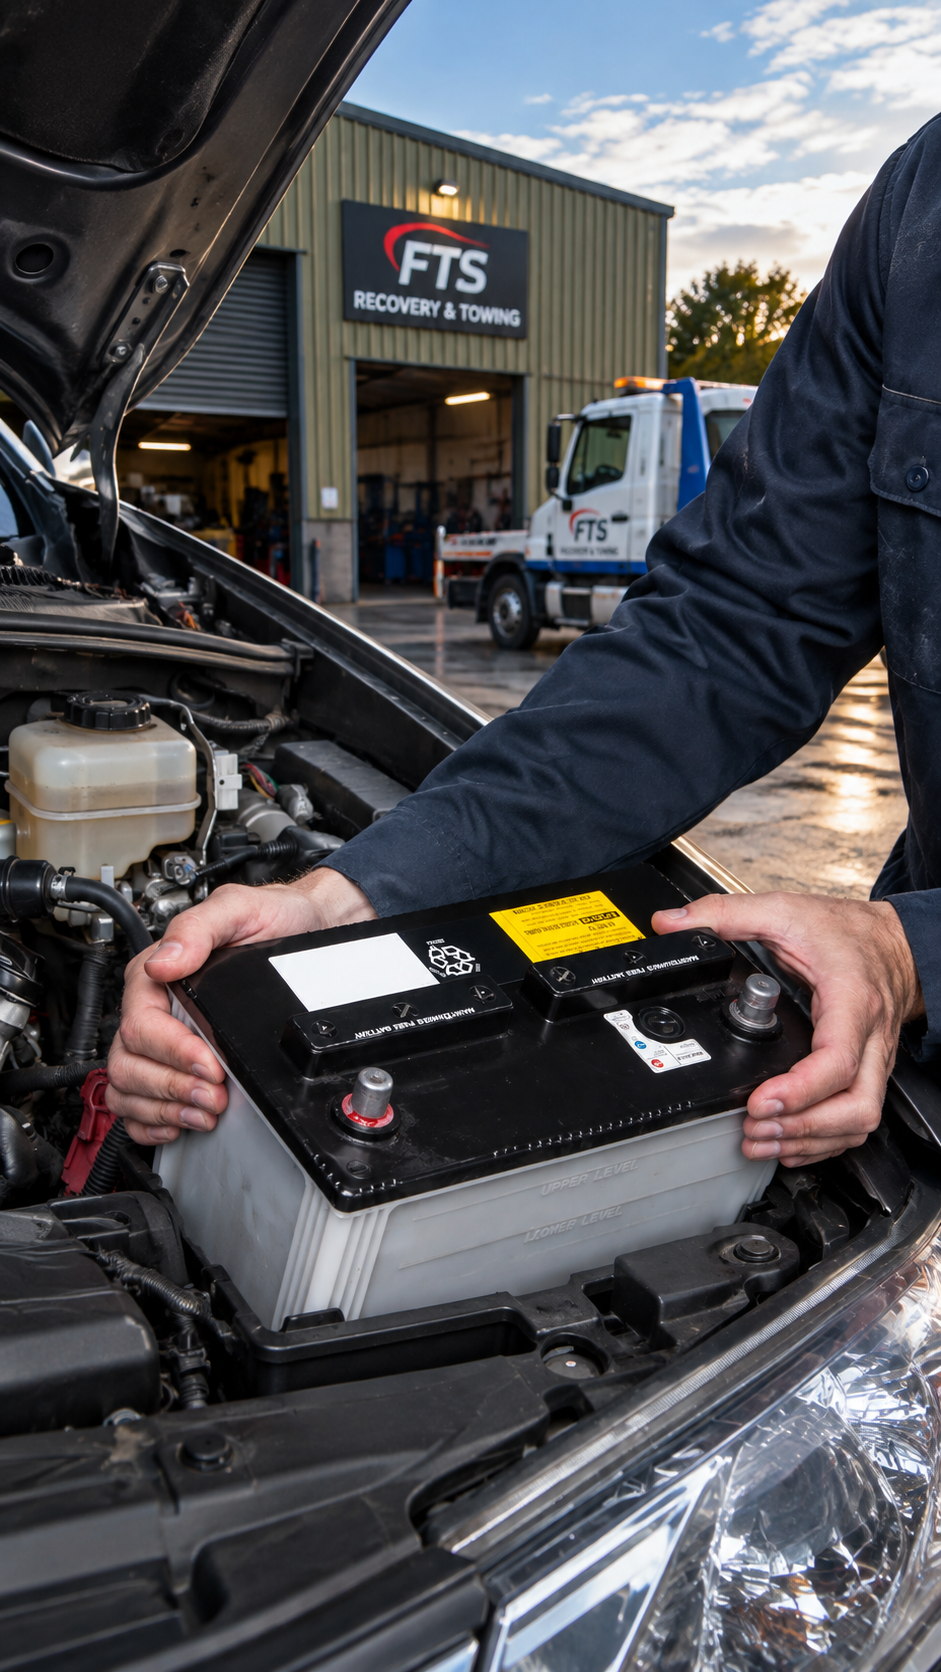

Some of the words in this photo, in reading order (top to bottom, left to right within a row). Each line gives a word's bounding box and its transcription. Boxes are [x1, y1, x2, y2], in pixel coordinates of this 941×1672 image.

[398, 239, 489, 294] FTS
[353, 289, 442, 319] RECOVERY
[443, 301, 457, 320] &
[458, 303, 522, 327] TOWING
[574, 518, 608, 542] FTS
[541, 1173, 589, 1197] UPPER
[592, 1159, 639, 1183] LEVEL
[580, 1205, 623, 1227] LEVEL
